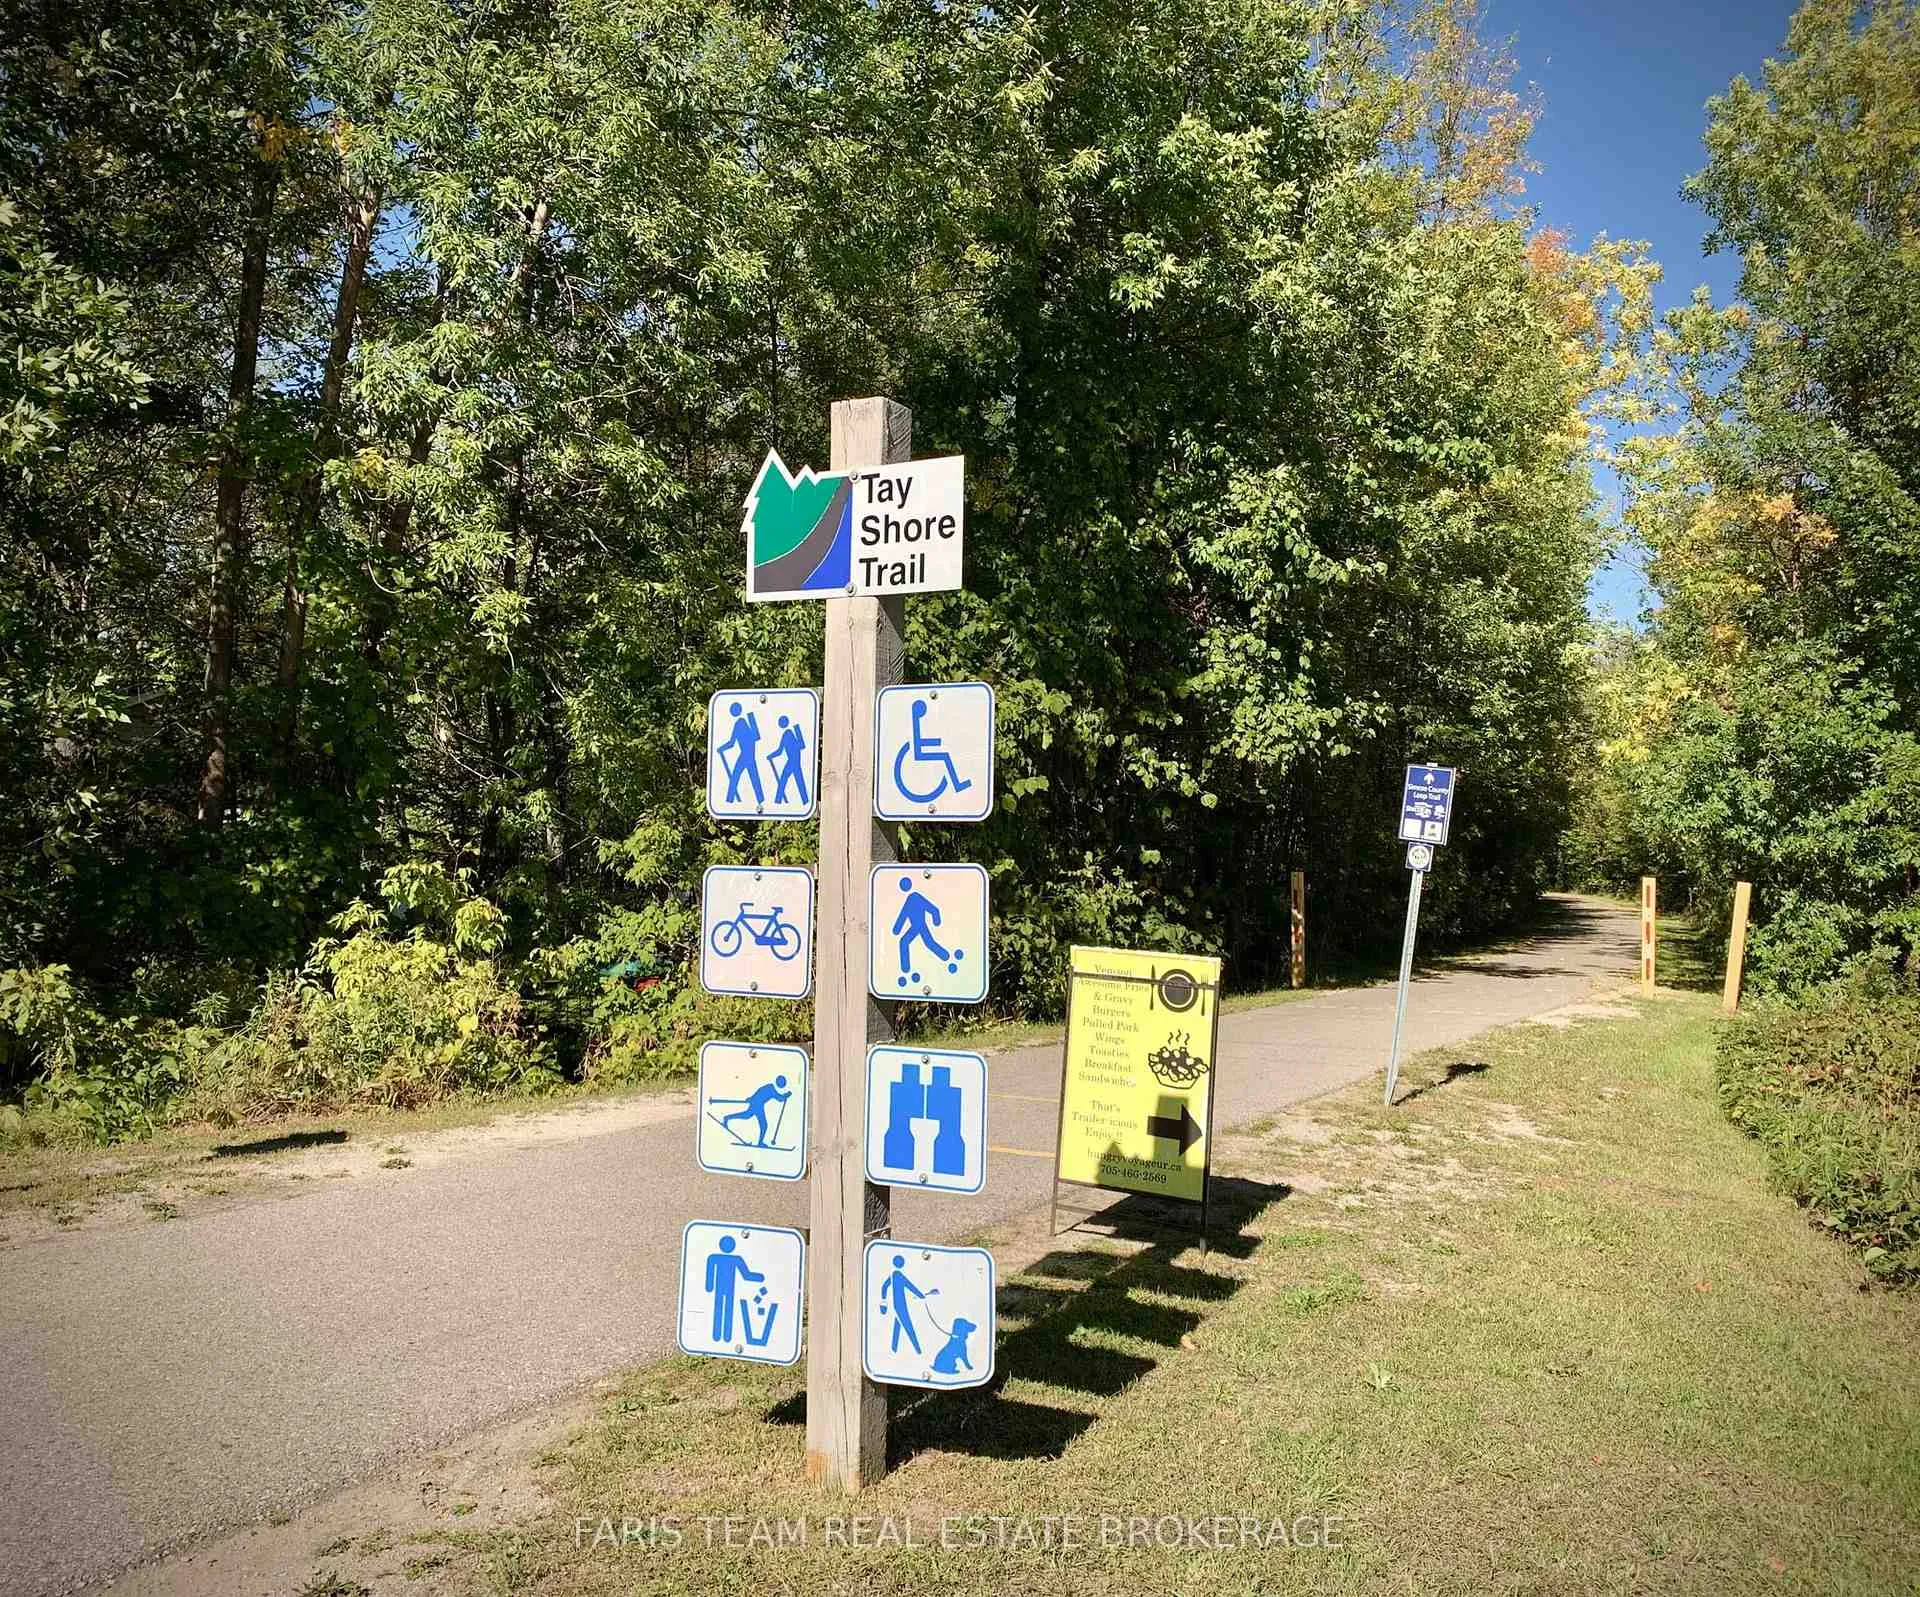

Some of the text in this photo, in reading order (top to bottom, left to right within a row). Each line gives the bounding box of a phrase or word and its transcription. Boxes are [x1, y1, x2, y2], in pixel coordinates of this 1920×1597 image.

[861, 473, 912, 509] Tay
[861, 514, 956, 546] Shore
[859, 553, 925, 587] Trail
[1104, 993, 1135, 1006] Gravy
[1092, 1004, 1131, 1018] Burgers
[1082, 1016, 1139, 1033] Pulled Pork
[1095, 1031, 1125, 1045] Wings
[1084, 1057, 1132, 1073] Breakfast
